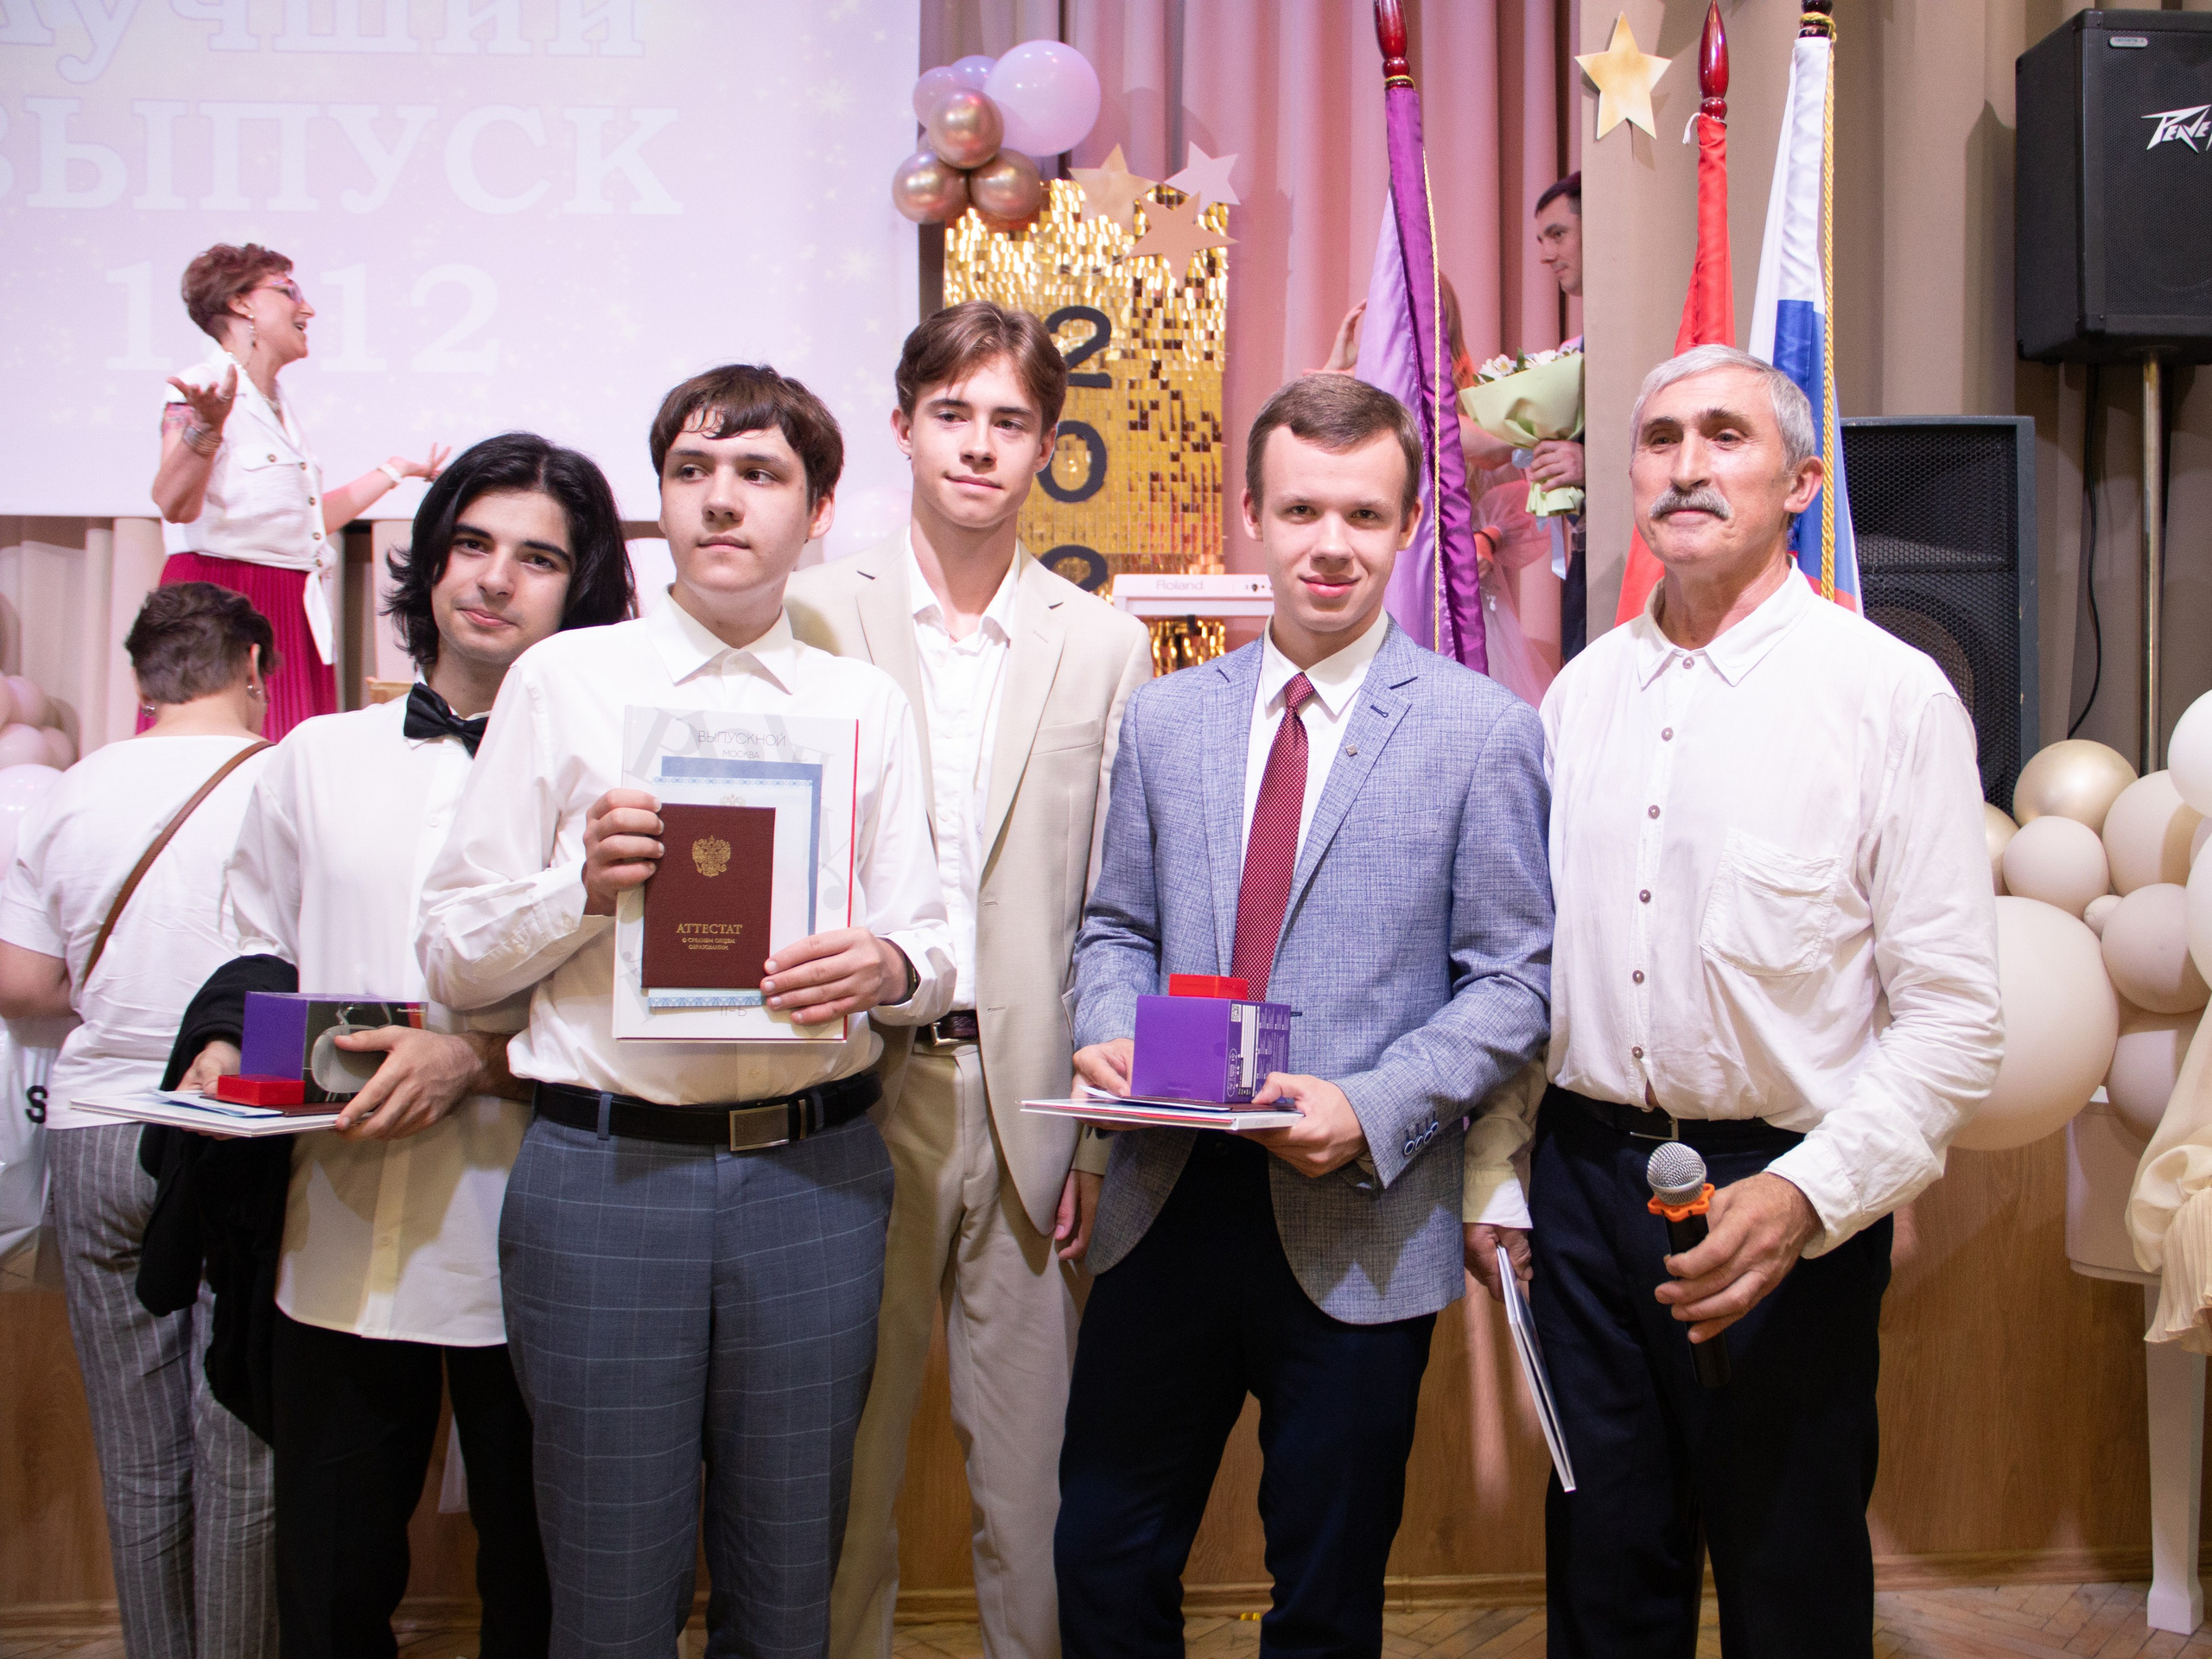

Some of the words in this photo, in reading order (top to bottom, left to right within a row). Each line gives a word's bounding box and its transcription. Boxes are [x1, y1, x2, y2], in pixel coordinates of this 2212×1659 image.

[2140, 104, 2212, 155] PEAVE
[0, 95, 684, 217] ЫПУСК
[105, 261, 501, 377] 112
[1156, 579, 1204, 591] Roland
[698, 729, 786, 747] ВЫПУСКНОЙ
[722, 749, 760, 759] МОСКВА
[676, 923, 743, 935] АТТЕСТАТ
